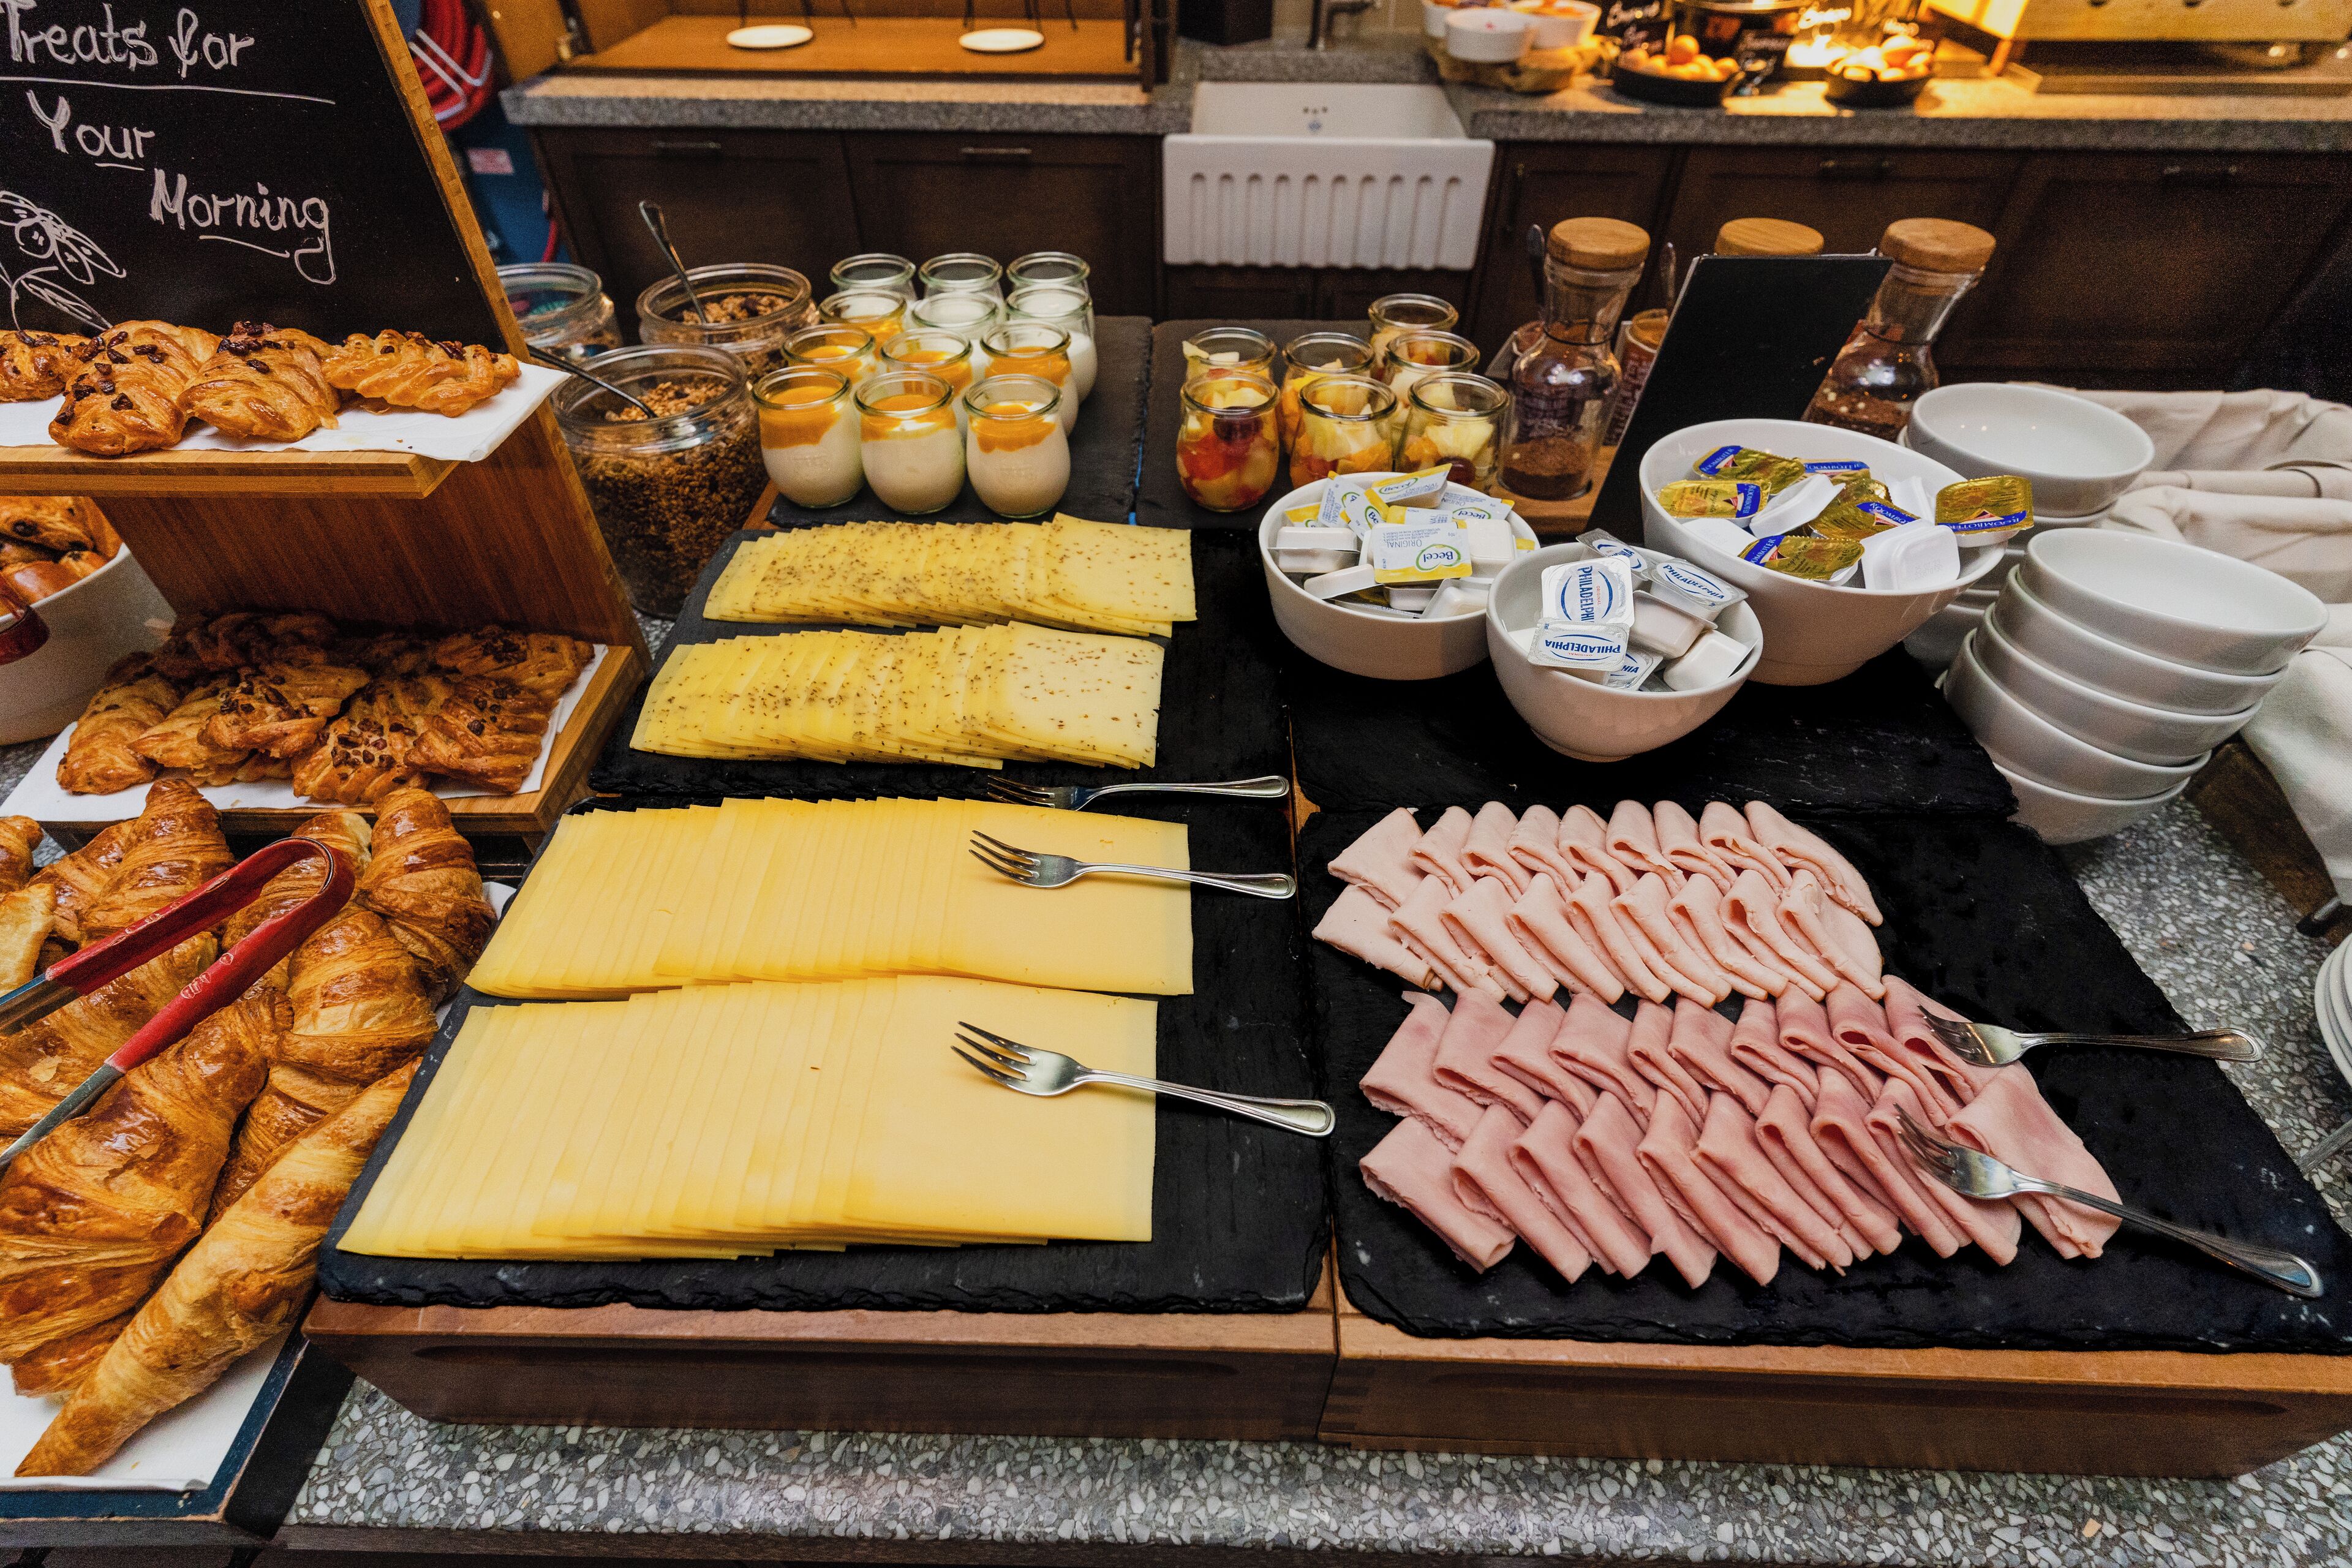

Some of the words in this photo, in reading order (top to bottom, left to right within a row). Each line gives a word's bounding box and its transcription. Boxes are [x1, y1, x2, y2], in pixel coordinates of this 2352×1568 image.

[0, 0, 158, 71] Treats
[168, 8, 255, 78] for
[25, 89, 156, 160] Your
[149, 167, 336, 285] Morning
[1458, 510, 1487, 520] Becel
[1385, 539, 1422, 549] ORIGINAL
[1422, 550, 1454, 563] Becel
[1577, 565, 1594, 622] PHILADELPHI
[1663, 564, 1725, 600] PHILADELPHIA
[1544, 639, 1621, 654] PHILADELPHIA
